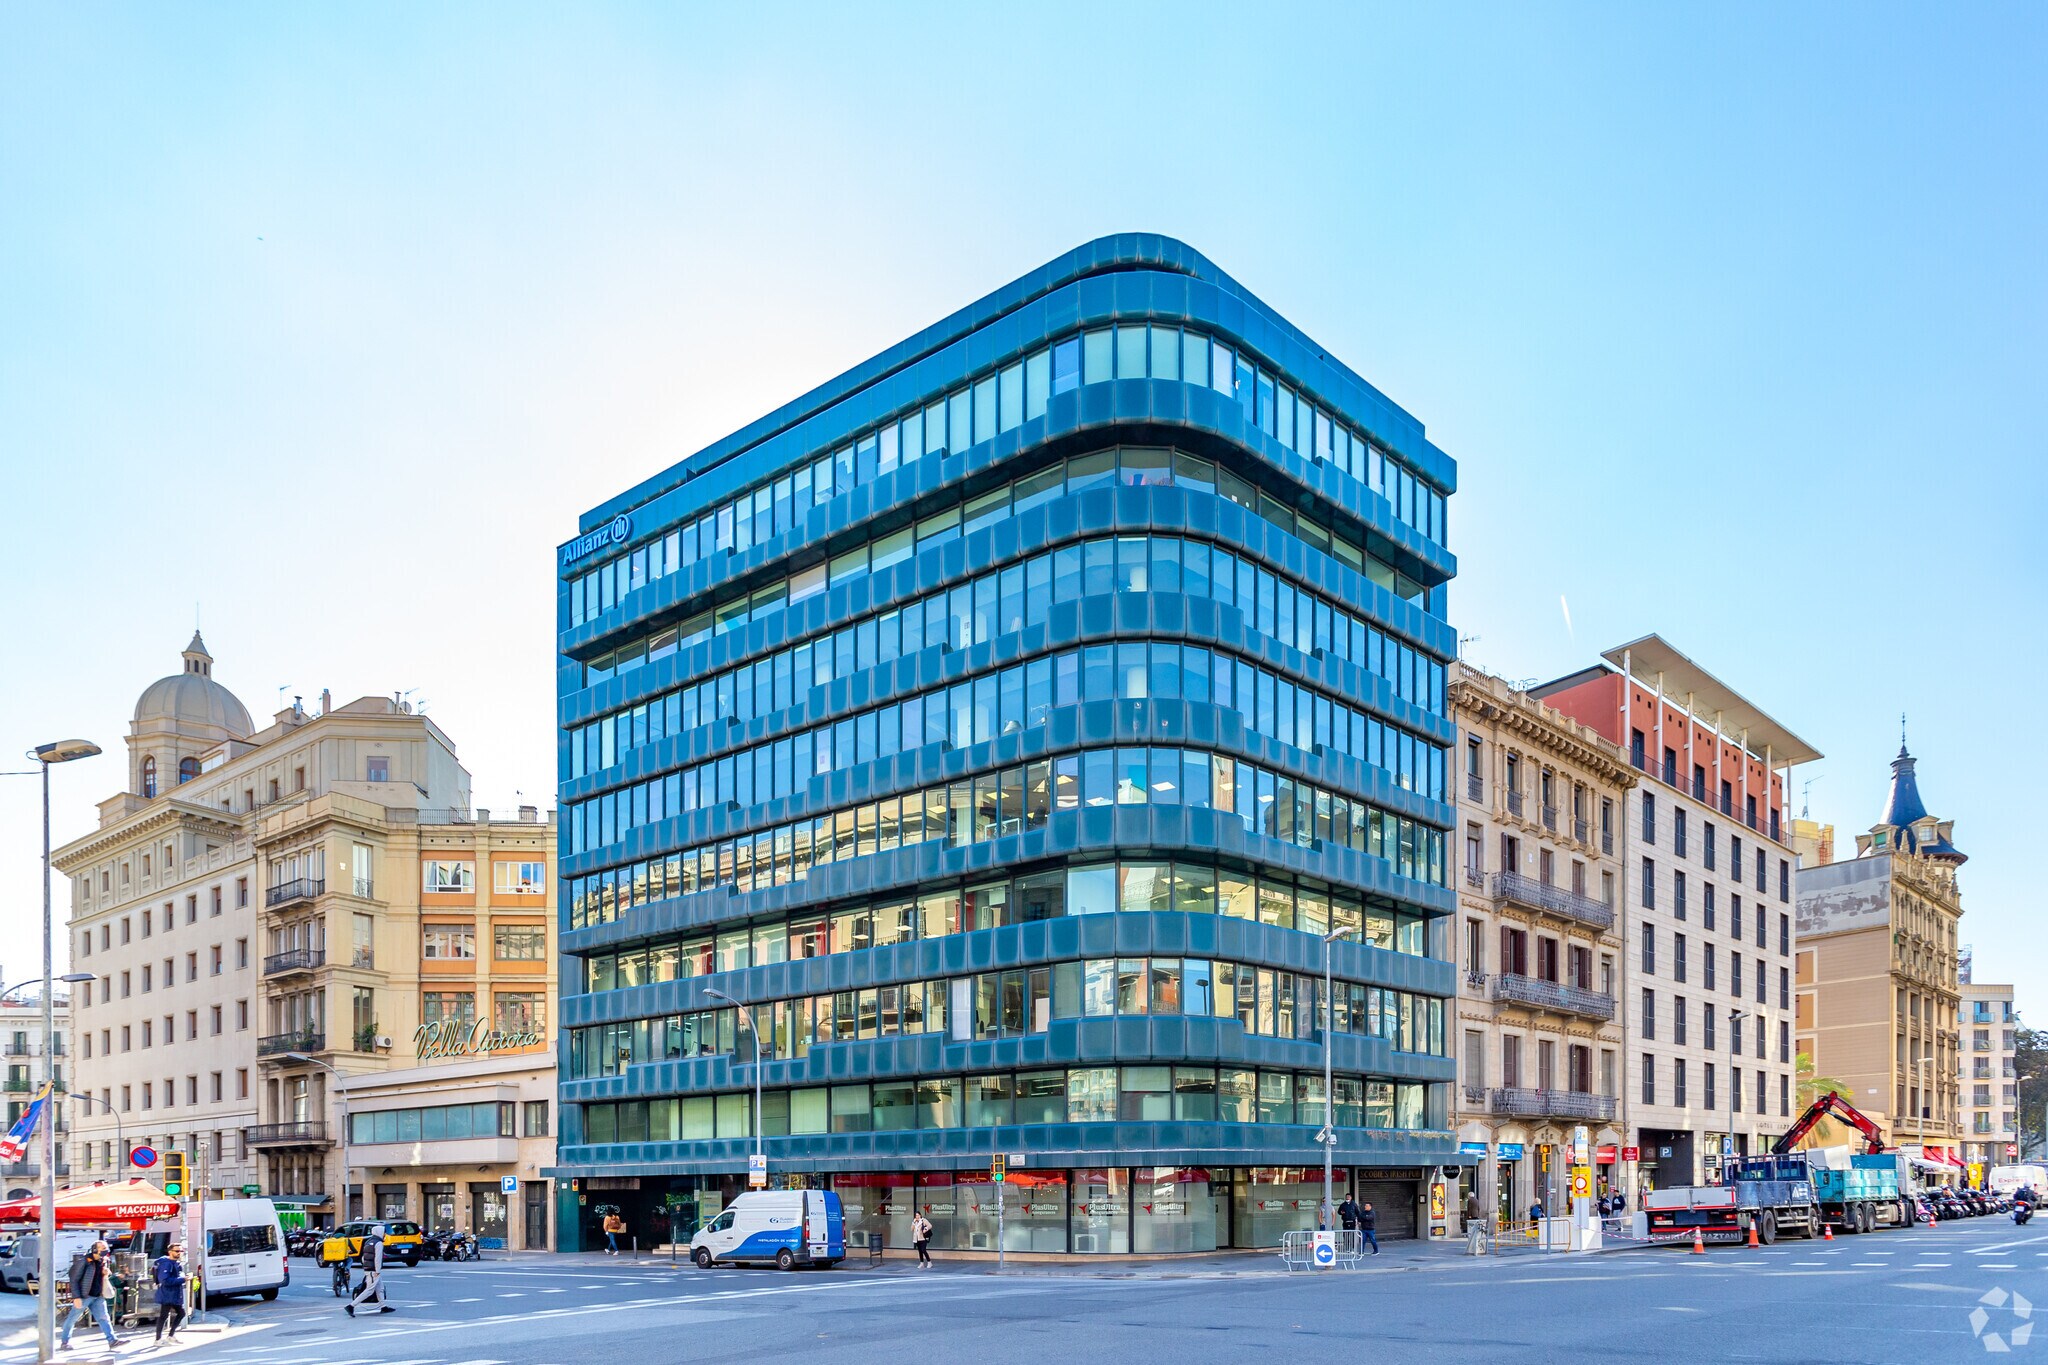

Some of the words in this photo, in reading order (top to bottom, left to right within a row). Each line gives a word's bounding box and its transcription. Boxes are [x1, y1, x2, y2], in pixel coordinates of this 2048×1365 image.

[563, 528, 610, 566] Allianz
[413, 1018, 466, 1060] Bella
[467, 1016, 540, 1054] Aurora
[1662, 1148, 1669, 1156] P
[504, 1177, 514, 1190] P
[119, 1204, 170, 1214] MACCHINA
[1701, 1232, 1738, 1241] BAZTAN
